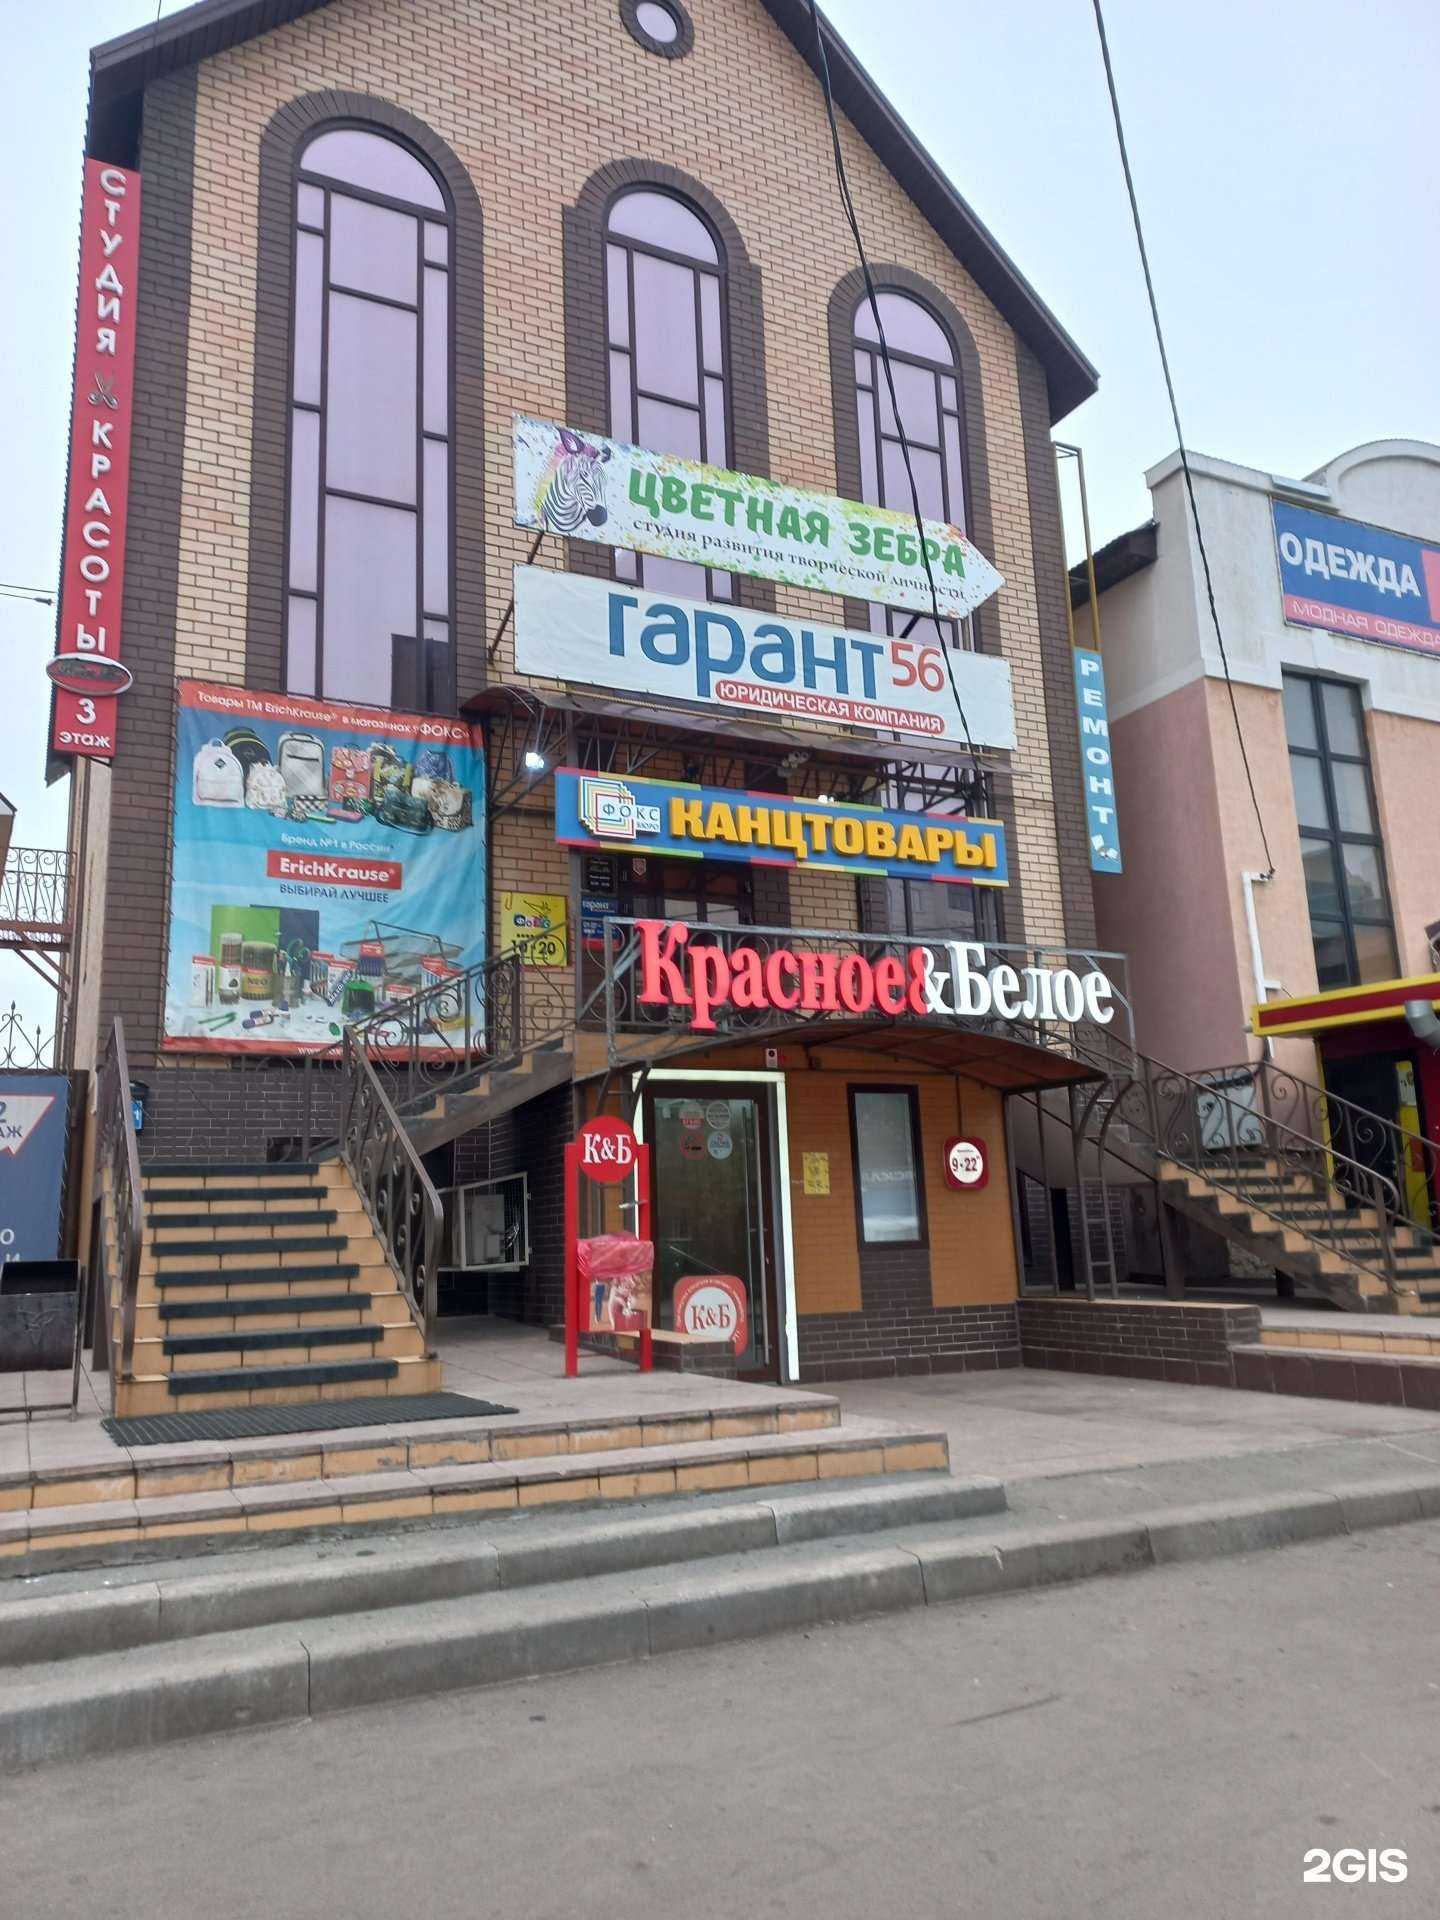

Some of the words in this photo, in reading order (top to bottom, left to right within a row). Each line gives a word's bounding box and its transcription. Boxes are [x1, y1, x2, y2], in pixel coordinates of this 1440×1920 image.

[96, 168, 127, 356] СТУДИЯ
[77, 420, 113, 652] КРАСОТЫ
[628, 467, 830, 548] ЦВЕТНАЯ
[848, 522, 966, 579] ЗЕБРА
[633, 519, 697, 543] студия
[702, 533, 784, 562] развития
[788, 553, 886, 584] творческой
[1279, 531, 1422, 598] ОДЕЖДА
[1292, 600, 1370, 631] МОДНАЯ
[75, 697, 97, 724] 3
[198, 690, 244, 709] Товары
[246, 699, 262, 712] ТМ
[719, 681, 850, 717] ЮРИДИЧЕСКАЯ
[854, 705, 942, 733] КОМПАНИЯ
[58, 730, 112, 749] этаж
[1080, 659, 1114, 824] РЕМОНТ
[602, 803, 659, 822] ФОКС
[670, 797, 998, 869] КАНЦТОВАРЫ
[279, 883, 338, 899] ВЫБИРАЙ
[340, 887, 390, 904] ЛУЧШЕЕ
[582, 1132, 632, 1165] К&Б
[691, 1304, 730, 1331] К&Б
